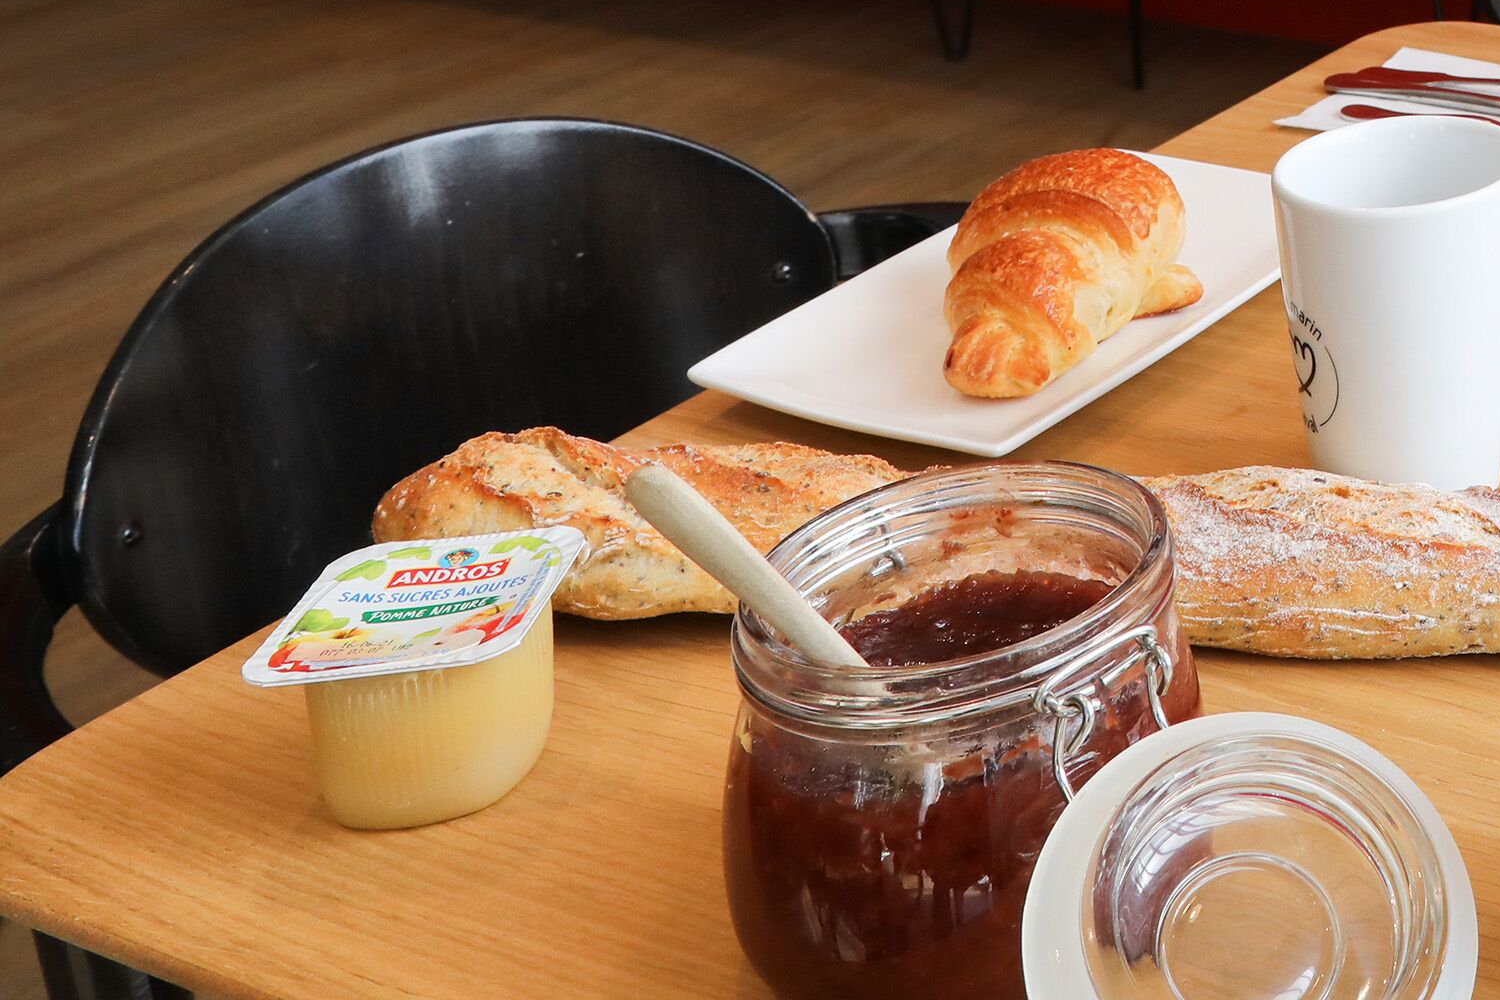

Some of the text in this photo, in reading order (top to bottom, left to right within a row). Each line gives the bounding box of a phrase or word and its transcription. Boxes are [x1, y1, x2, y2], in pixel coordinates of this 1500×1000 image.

[391, 561, 504, 586] ANDROS
[338, 591, 385, 603] SANS
[386, 589, 450, 603] SUCRES
[369, 598, 487, 623] POMME NATURE
